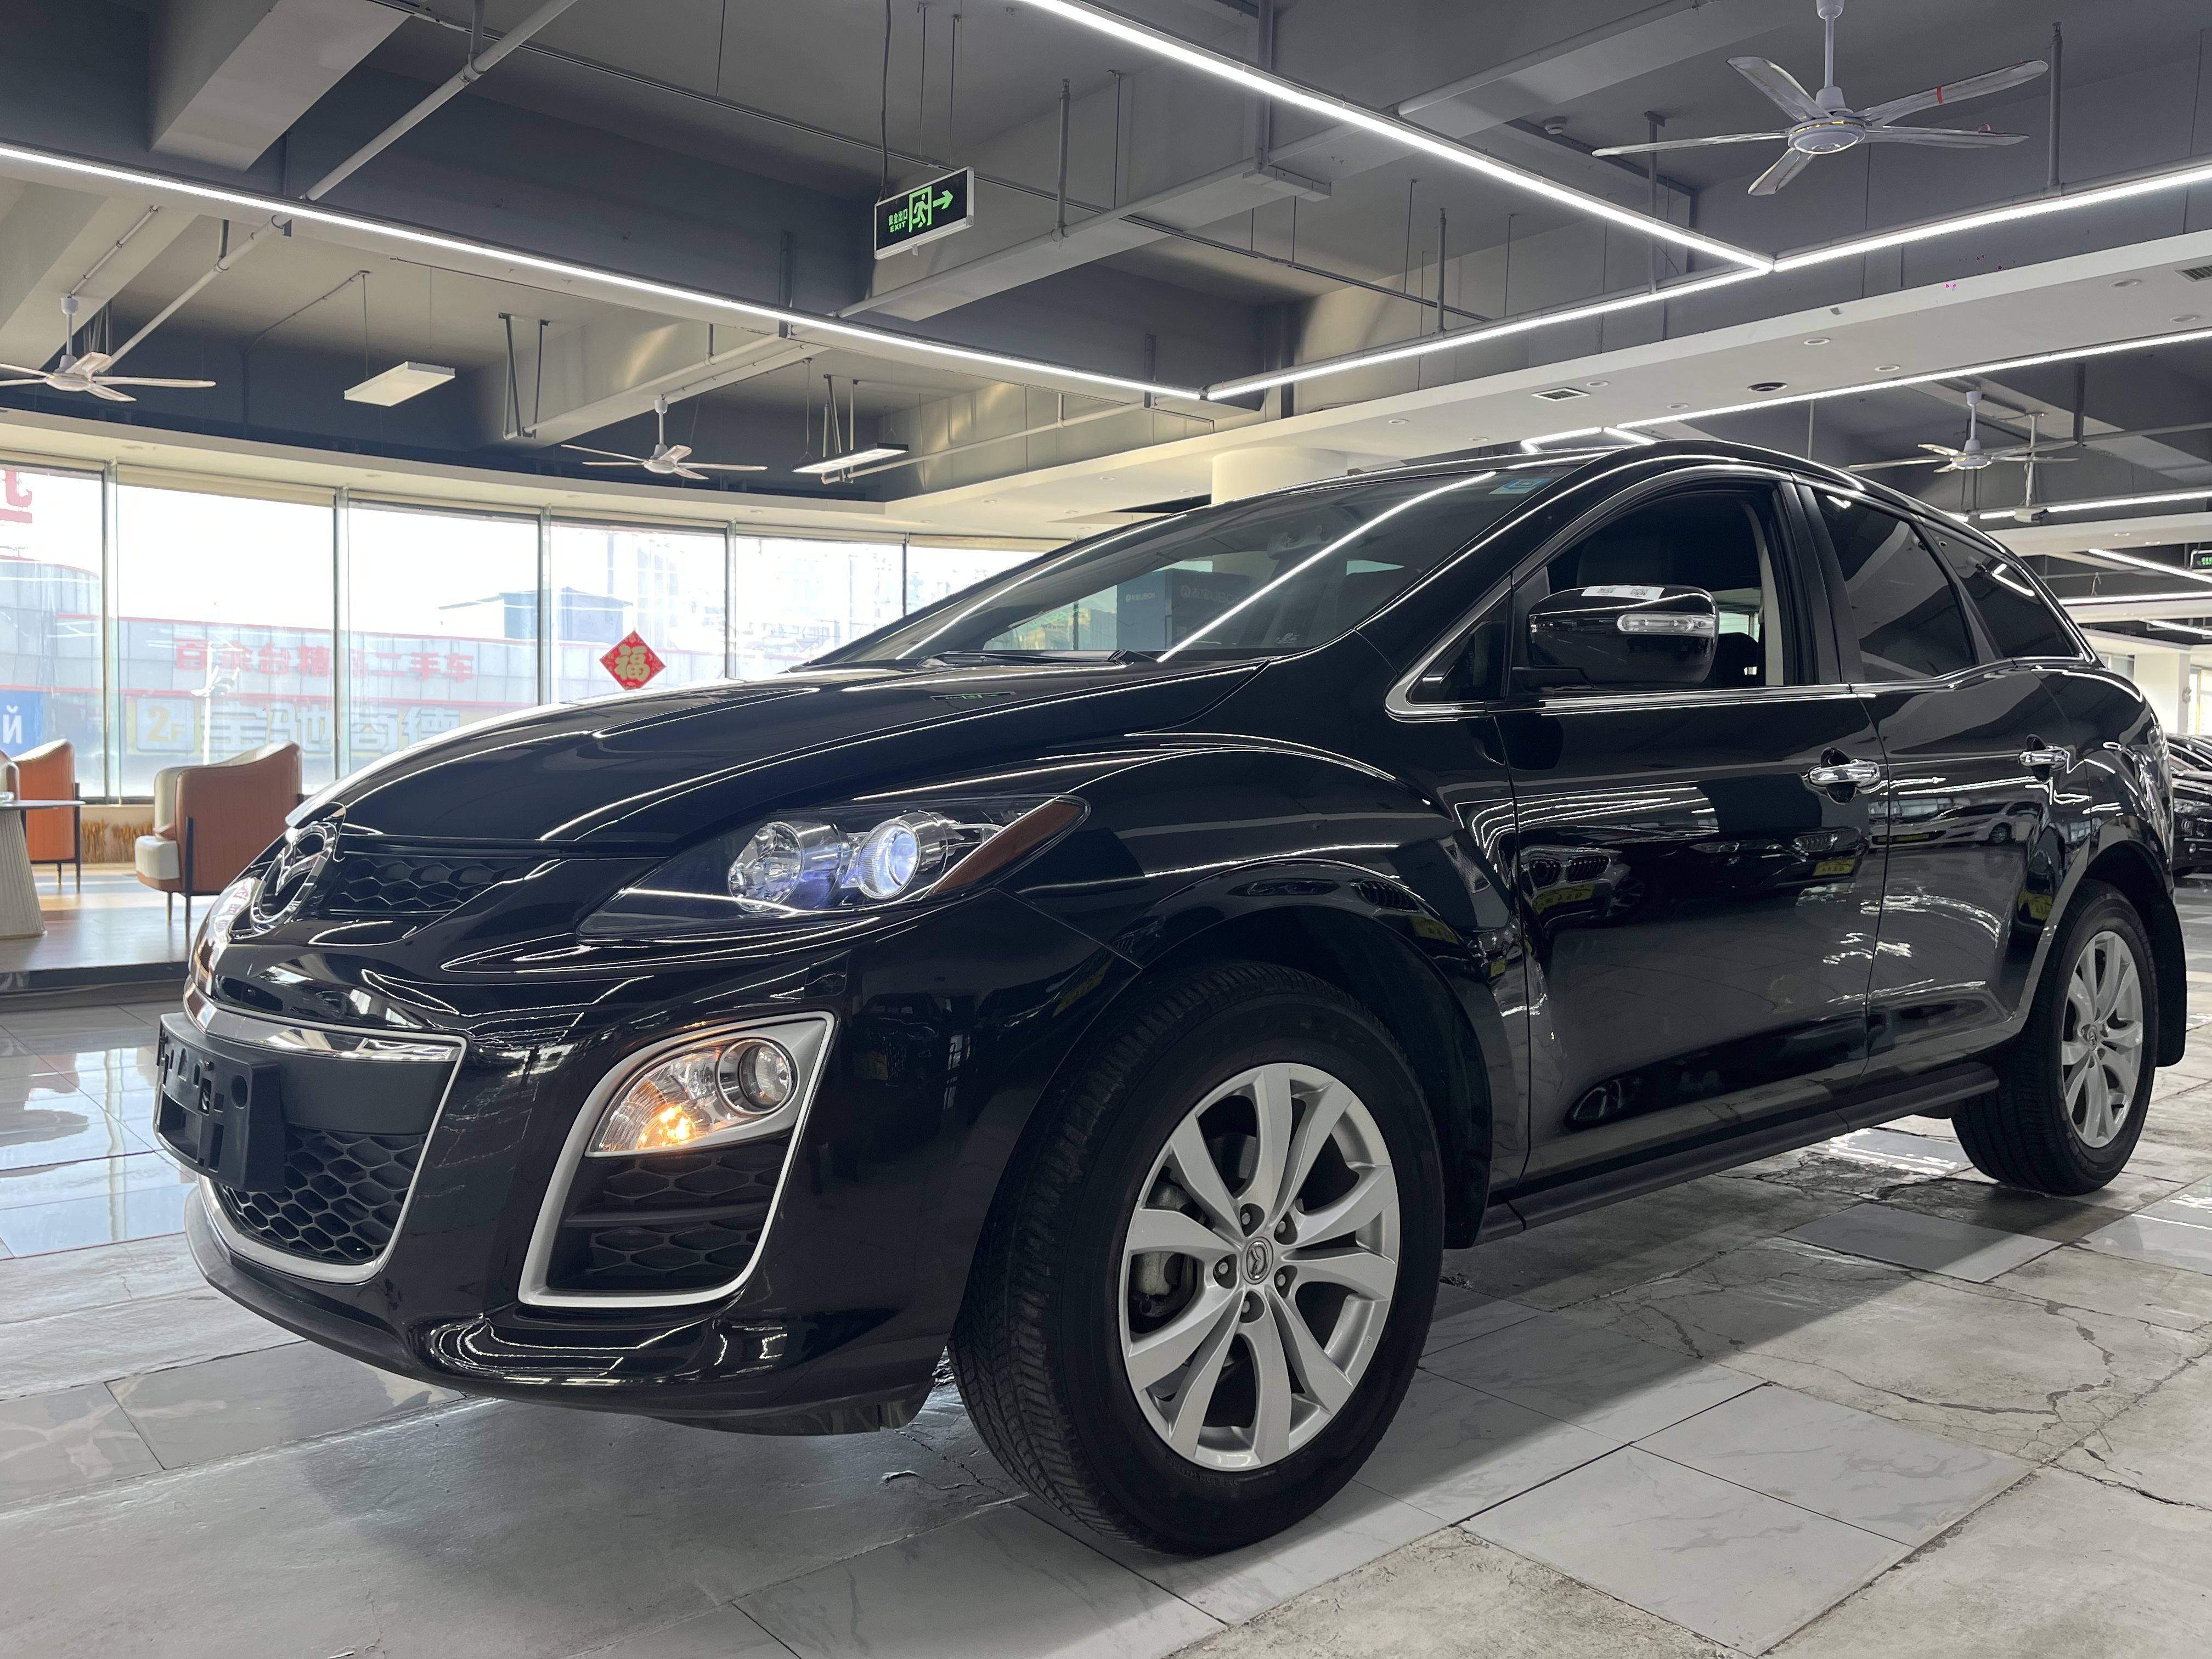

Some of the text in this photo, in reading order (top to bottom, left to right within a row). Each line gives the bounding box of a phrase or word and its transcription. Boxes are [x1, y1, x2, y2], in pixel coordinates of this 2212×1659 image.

[888, 208, 908, 226] 安全出口
[890, 221, 906, 233] EXIT
[1132, 591, 1156, 600] UBOX
[614, 643, 651, 682] 福
[146, 704, 185, 742] 2F
